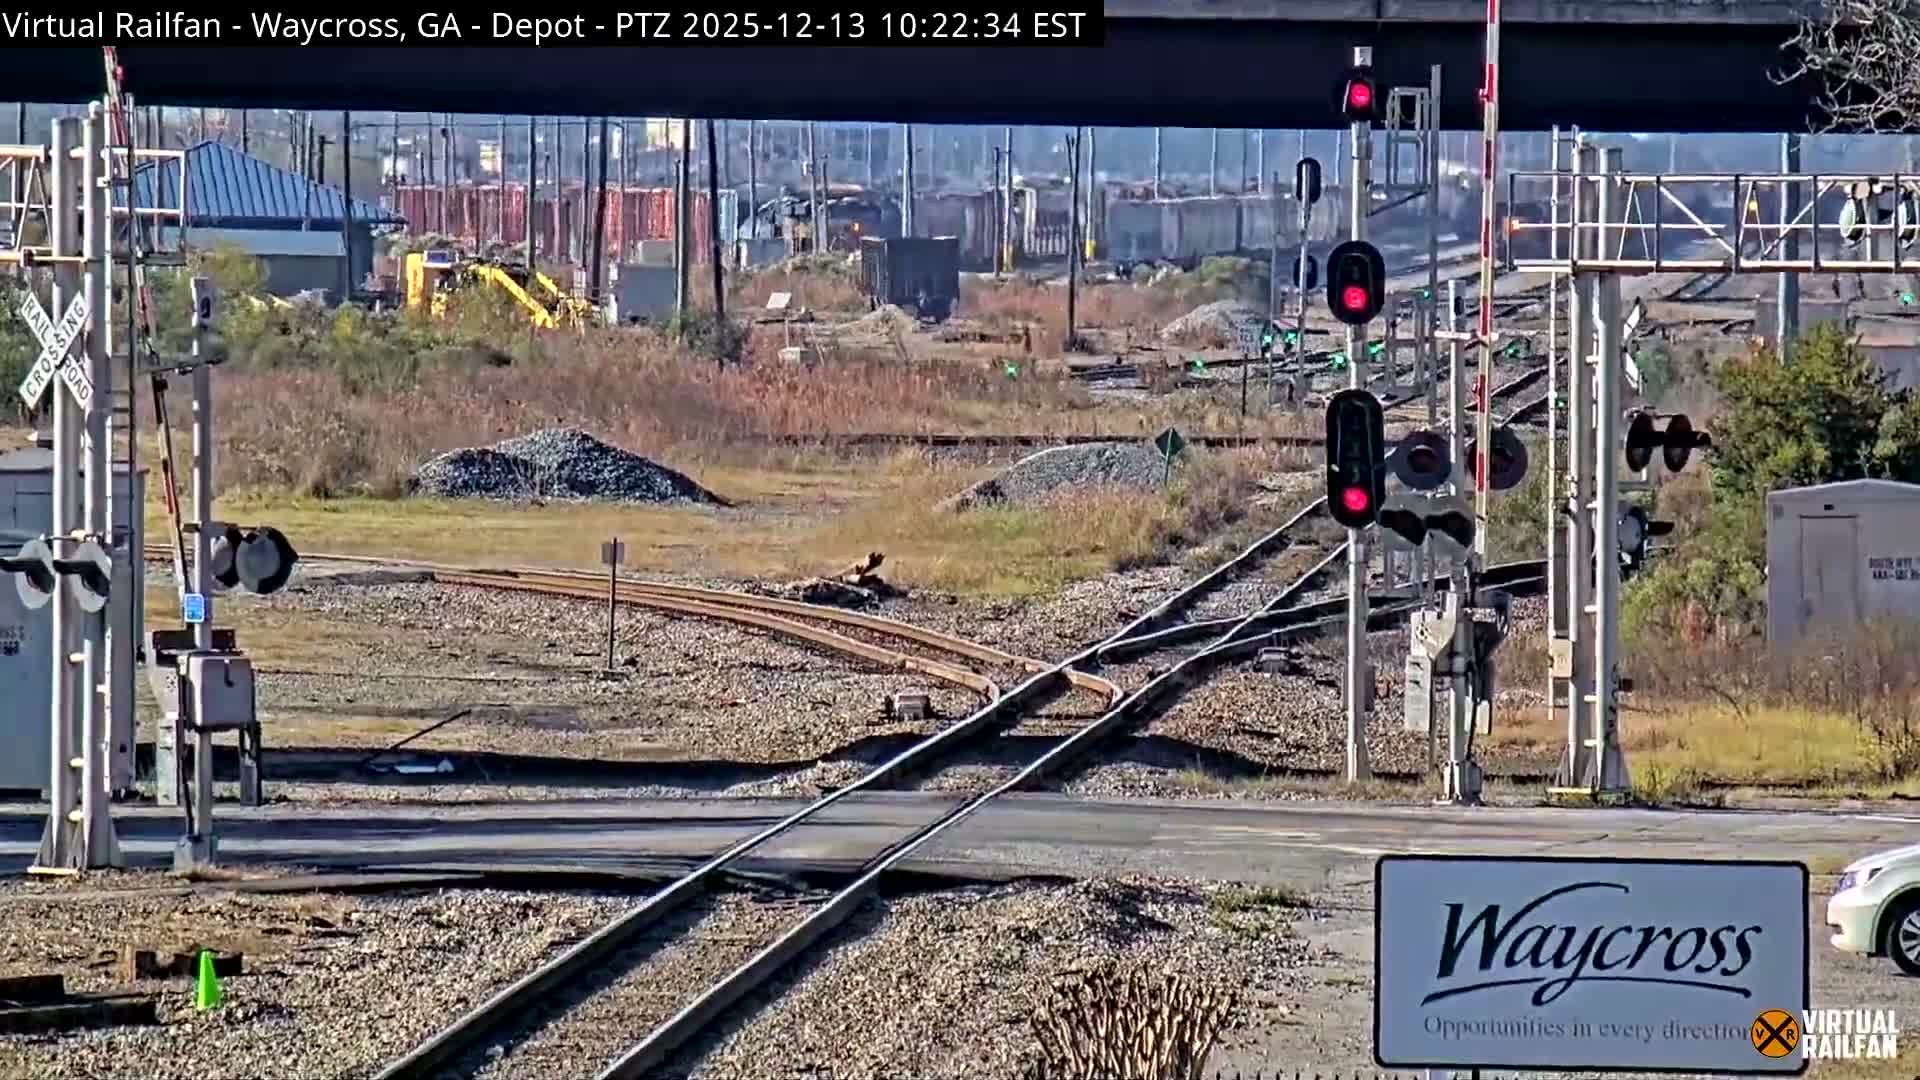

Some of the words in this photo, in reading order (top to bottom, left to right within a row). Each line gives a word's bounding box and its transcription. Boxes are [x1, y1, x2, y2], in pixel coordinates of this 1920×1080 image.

[24, 299, 49, 342] RAIL
[63, 355, 89, 401] ROAD
[26, 302, 84, 398] CROSSING
[1436, 882, 1763, 1006] Waycross
[1423, 1014, 1565, 1042] Opportunities
[1572, 1015, 1592, 1039] in
[1599, 1020, 1652, 1044] every
